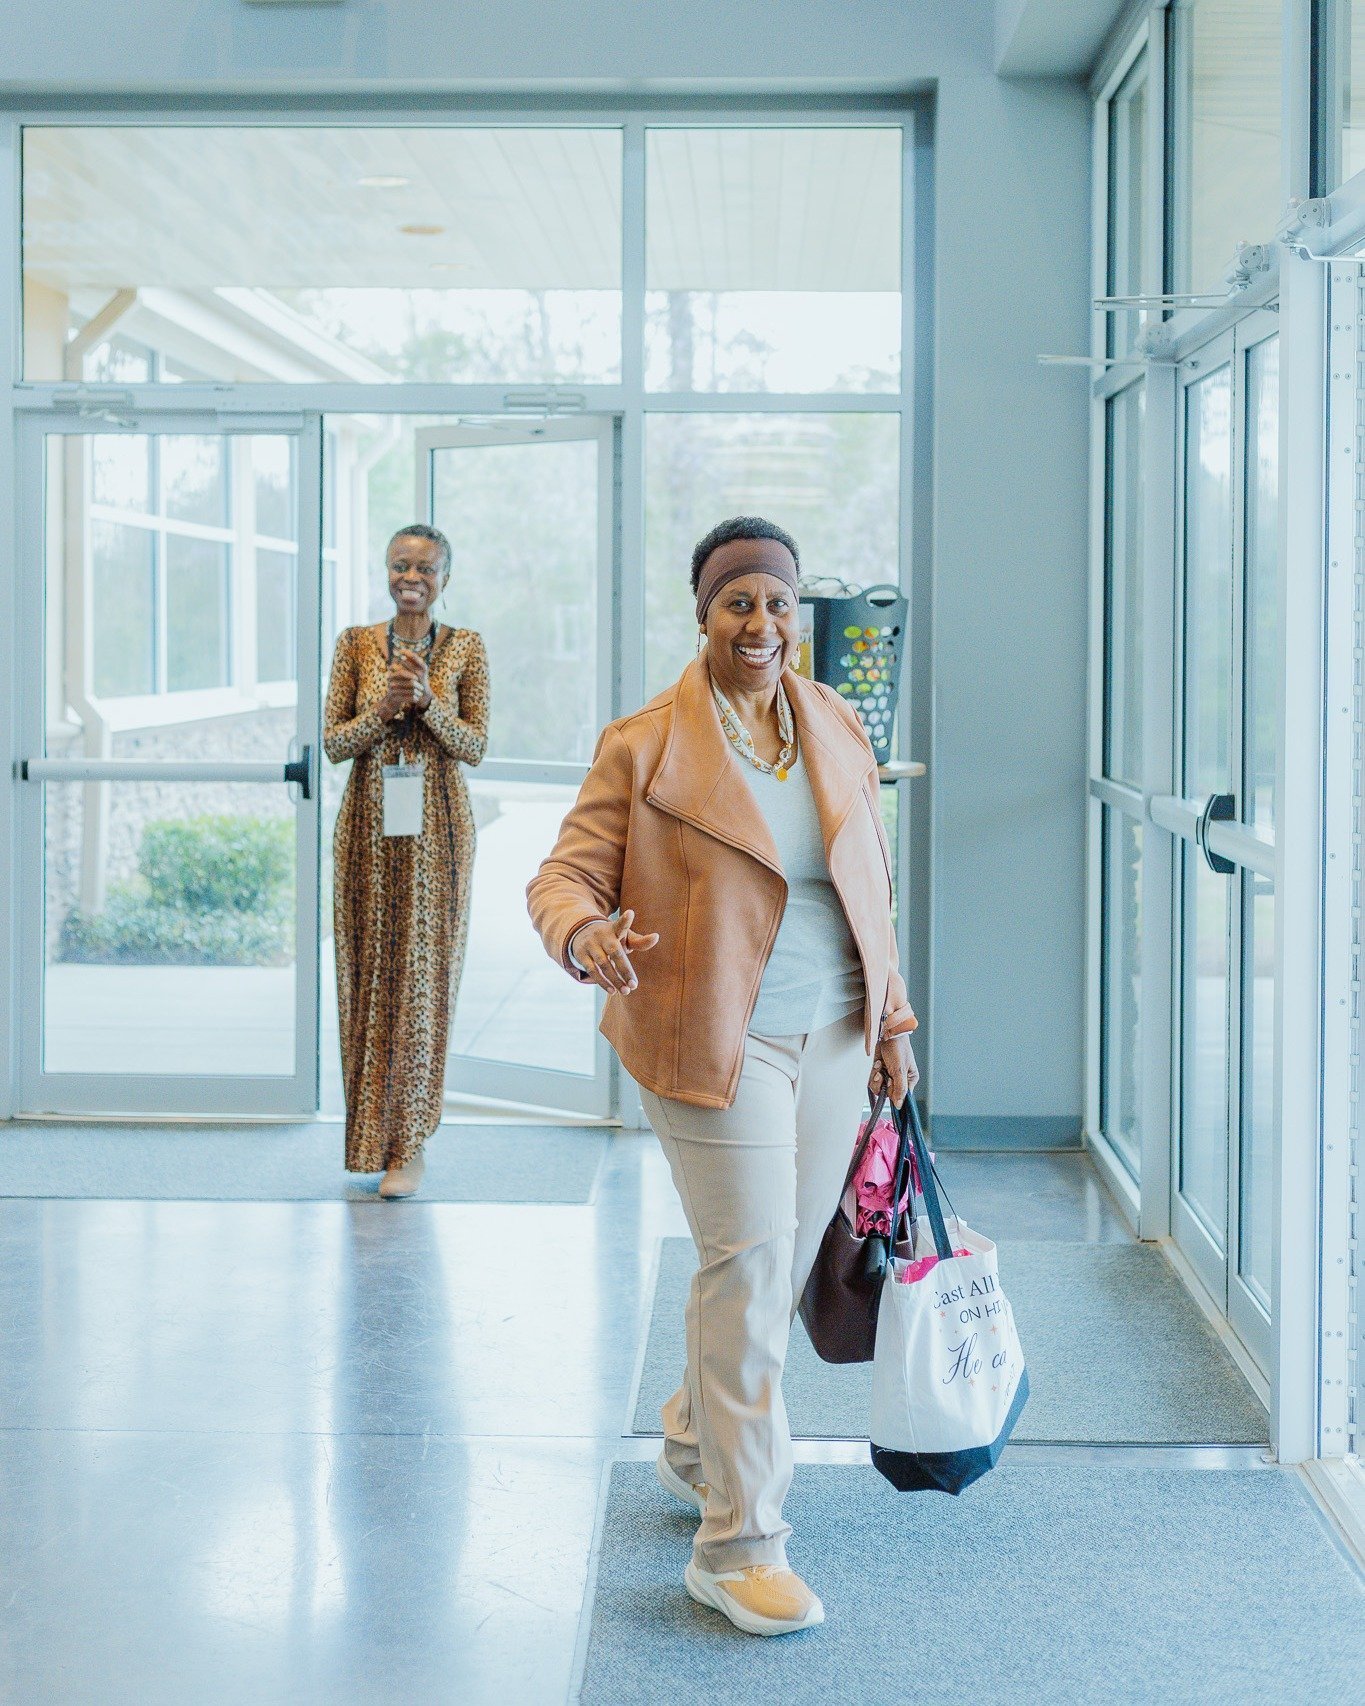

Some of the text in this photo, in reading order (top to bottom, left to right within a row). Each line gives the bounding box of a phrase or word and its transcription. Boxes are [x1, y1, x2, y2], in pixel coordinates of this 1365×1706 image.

[970, 1275, 995, 1297] All
[960, 1300, 1005, 1323] ON HI
[943, 1333, 982, 1385] He
